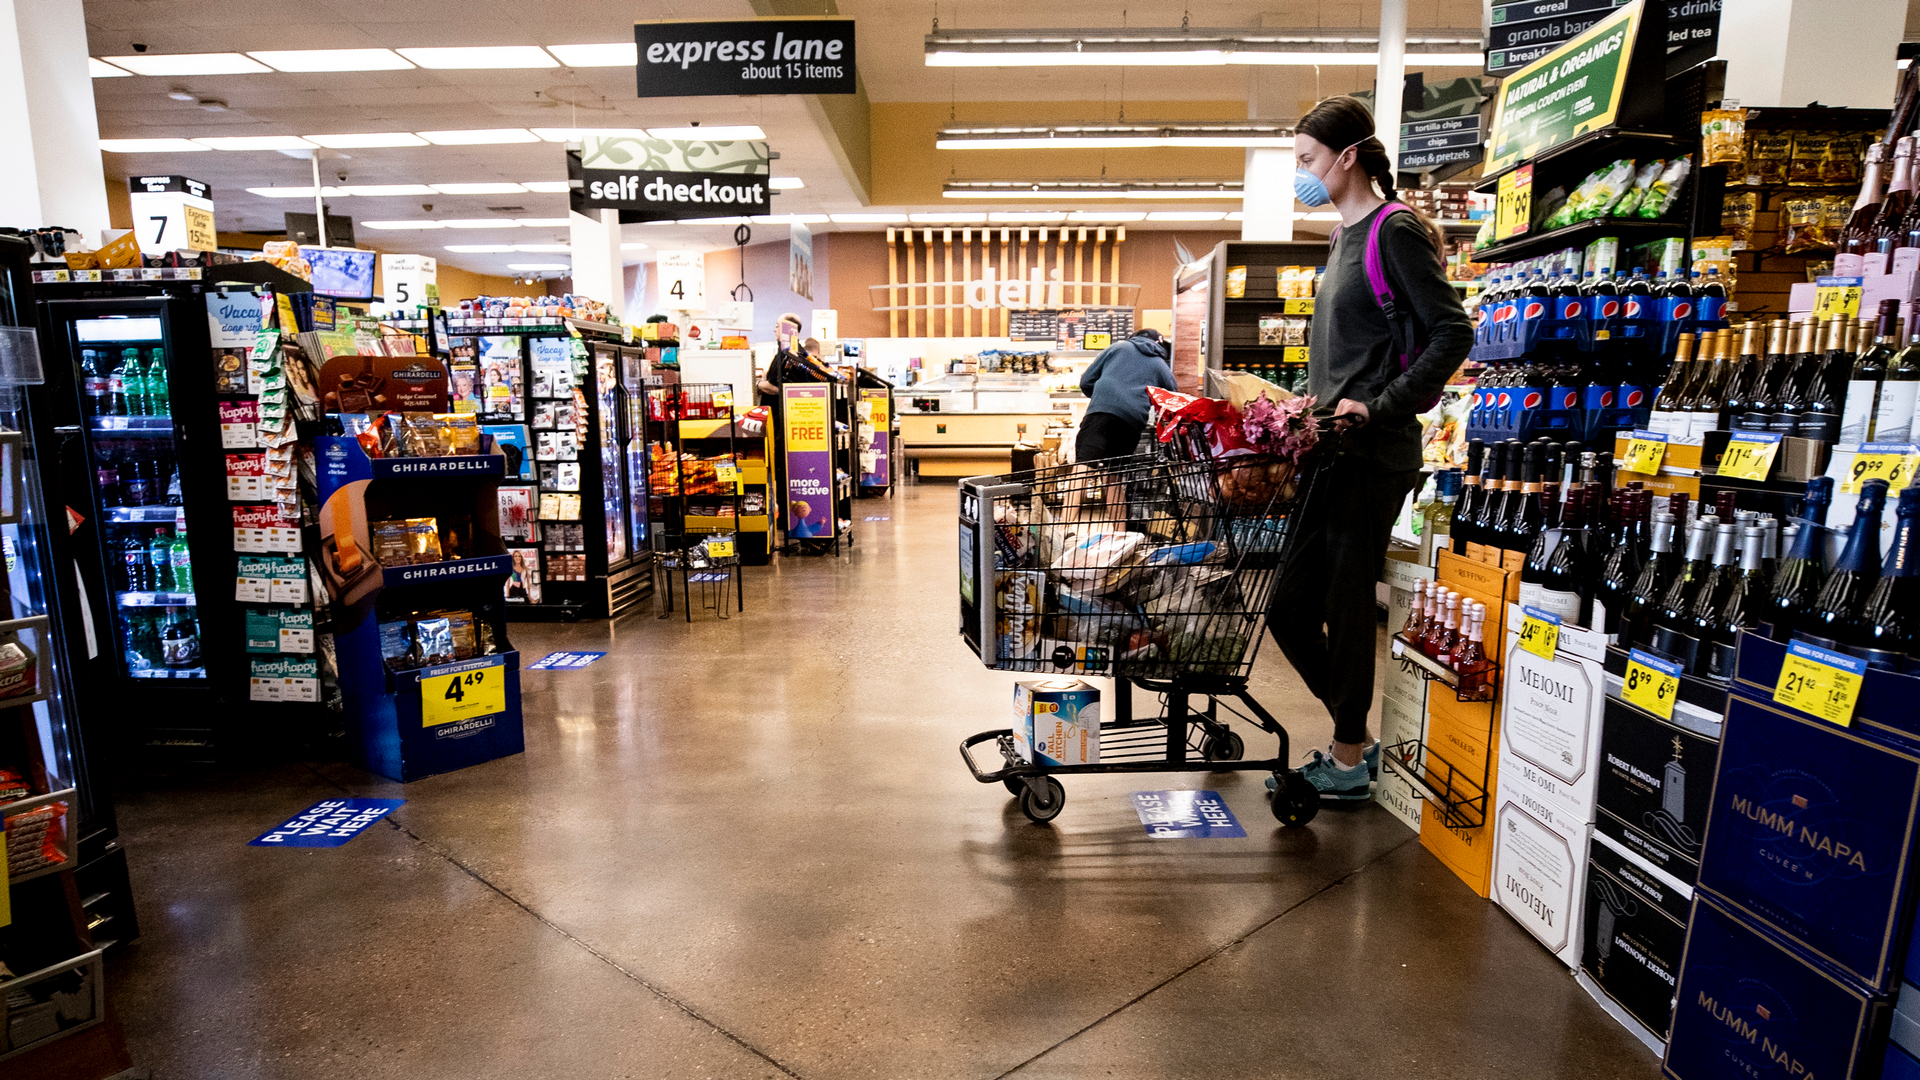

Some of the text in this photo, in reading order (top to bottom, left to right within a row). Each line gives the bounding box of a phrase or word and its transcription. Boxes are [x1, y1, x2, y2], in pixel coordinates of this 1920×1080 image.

[1534, 1, 1568, 14] cereal
[1508, 20, 1595, 46] granola bars
[1691, 27, 1711, 38] tea
[646, 32, 843, 69] express lane
[741, 63, 844, 79] about 15 items
[1506, 31, 1623, 107] NATURAL & ORGANICS
[1537, 85, 1567, 110] COUPON
[1565, 75, 1589, 96] EVENT
[1415, 120, 1463, 133] tortilla chips
[1427, 137, 1448, 147] chips
[1404, 149, 1471, 166] chips & pretzels
[590, 175, 764, 204] self checkout
[188, 208, 210, 221] Express
[1790, 202, 1822, 213] HARIBO
[150, 216, 168, 244] 7
[194, 217, 207, 229] Lane
[190, 229, 200, 243] 15
[396, 283, 409, 303] 5
[670, 280, 685, 300] 4
[966, 267, 1061, 309] deli
[220, 304, 263, 323] Vacay
[222, 323, 244, 332] done
[219, 405, 253, 419] happy
[742, 419, 763, 432] m
[791, 427, 824, 440] FREE
[226, 458, 260, 471] happy
[392, 461, 490, 473] GHIRARDELLI
[790, 479, 820, 487] more
[801, 487, 830, 496] save
[232, 510, 267, 522] happy
[237, 560, 271, 574] happy
[271, 561, 306, 575] happy
[403, 562, 498, 580] GHIRARDELLI
[1458, 569, 1486, 583] RUFFINO
[279, 612, 312, 625] happy
[1793, 645, 1811, 656] FRESH
[1811, 649, 1824, 661] FOR
[251, 661, 285, 674] happy
[284, 661, 317, 674] happy
[1519, 665, 1574, 704] MEIOMI
[437, 718, 493, 737] GHIRARDELLI
[1047, 733, 1055, 754] TALL
[1055, 721, 1063, 759] KITCHEN
[1448, 734, 1475, 756] RUFFINO
[1607, 752, 1661, 789] ROBERT MONDAVI
[1196, 799, 1233, 827] HERE
[1382, 789, 1421, 824] RUFFINO
[1522, 793, 1554, 823] MEIOMI
[261, 801, 345, 842] PLEASE
[299, 807, 359, 836] WAIT
[327, 807, 389, 837] HERE
[1731, 794, 1866, 872] MUMM NAPA
[1759, 848, 1814, 880] CUVÉE M
[1505, 873, 1555, 928] MEIOMI
[1614, 935, 1676, 986] ROBERT MONDAVI
[1698, 990, 1758, 1045] MUMM
